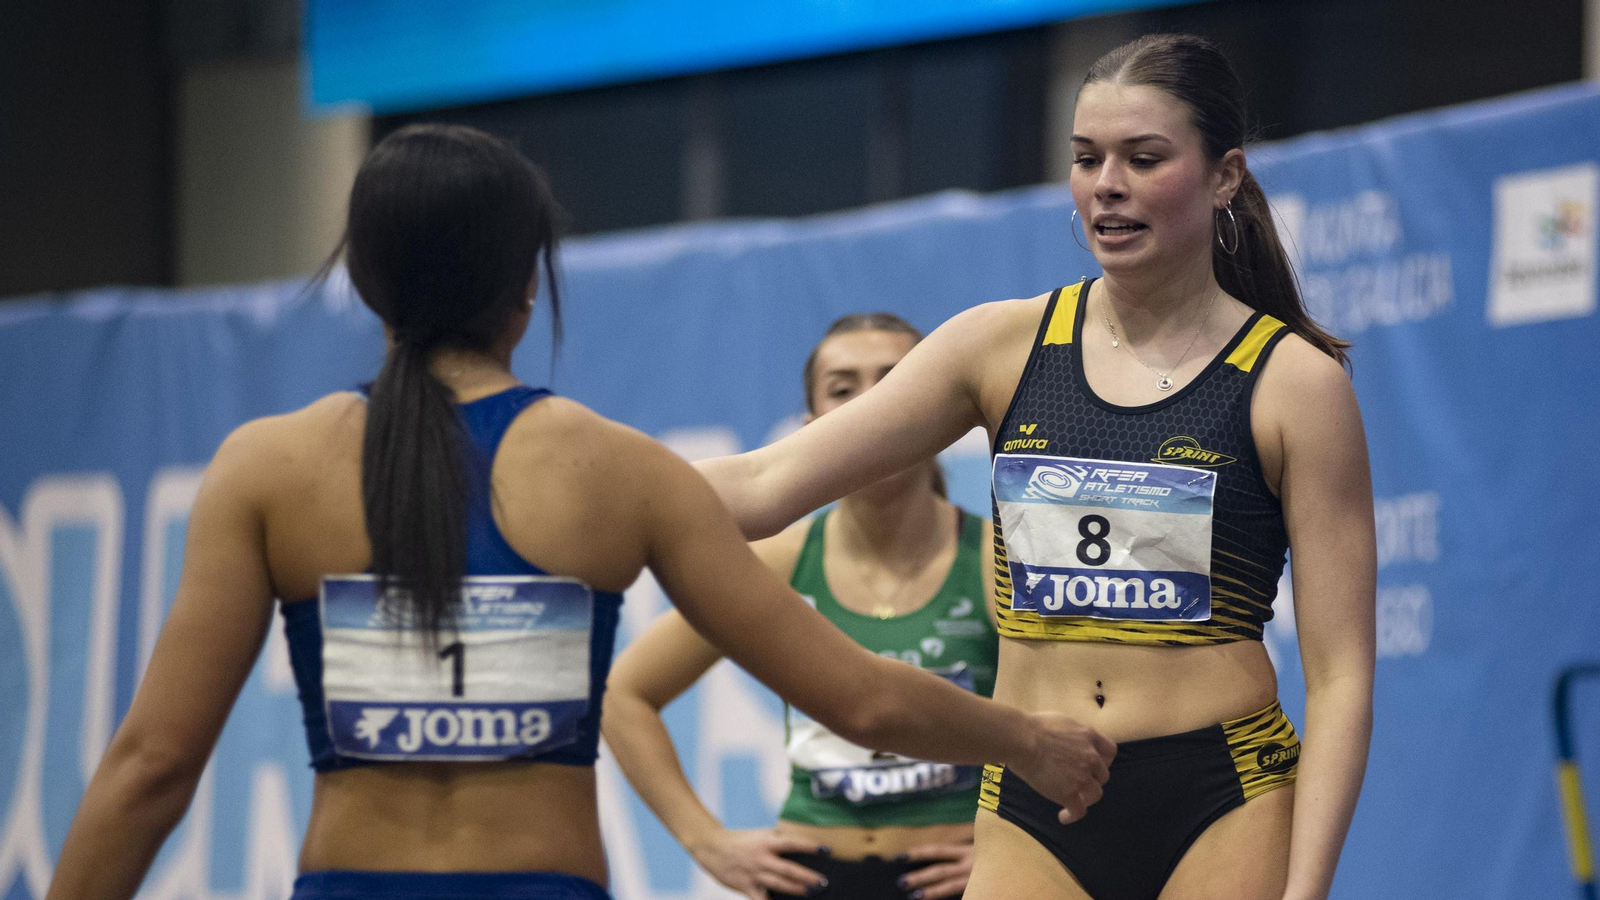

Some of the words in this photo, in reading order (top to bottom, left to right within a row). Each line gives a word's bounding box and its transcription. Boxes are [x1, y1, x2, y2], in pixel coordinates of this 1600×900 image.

[1003, 439, 1048, 451] amura
[1163, 446, 1220, 463] SPRINT
[1090, 468, 1149, 482] RFEA
[1083, 481, 1172, 496] ATLETISMO
[1079, 494, 1117, 504] SHORT
[1122, 497, 1159, 508] TRACK
[1076, 514, 1111, 566] 8
[439, 641, 464, 697] 1
